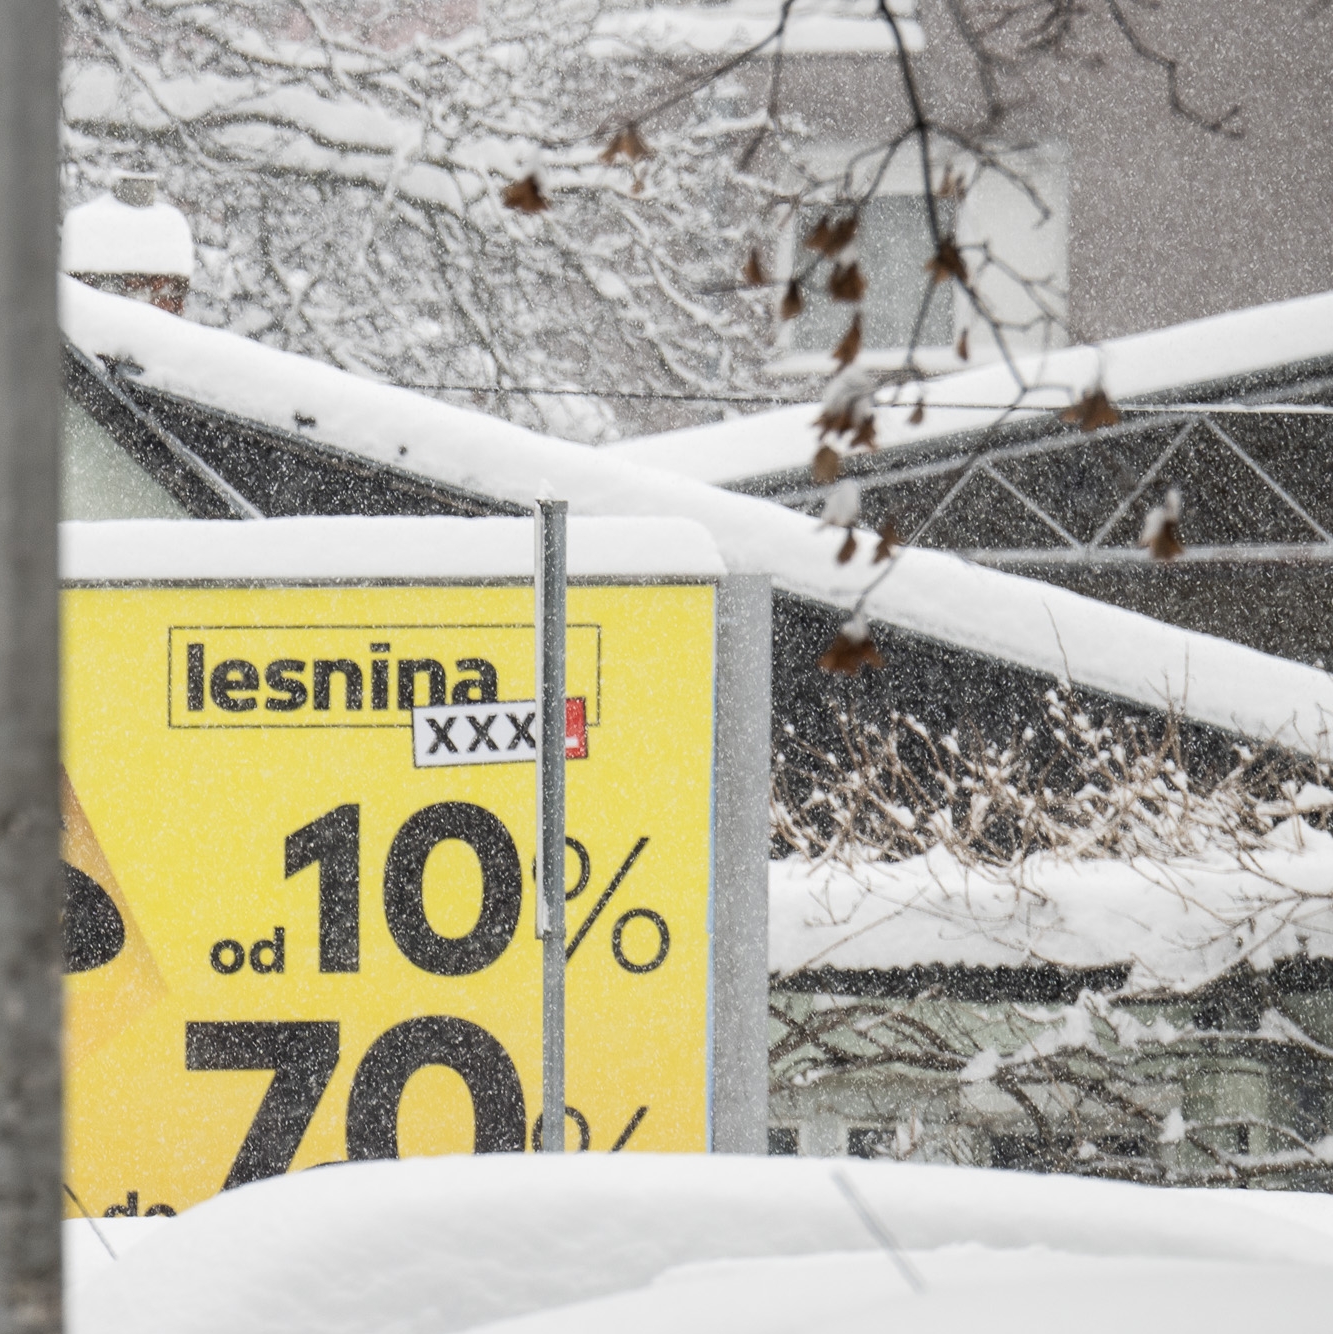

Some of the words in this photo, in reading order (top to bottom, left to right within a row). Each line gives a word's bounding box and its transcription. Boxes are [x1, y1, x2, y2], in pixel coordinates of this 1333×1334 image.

[186, 641, 501, 711] lesnina
[209, 926, 285, 974] od
[284, 801, 670, 976] 10%
